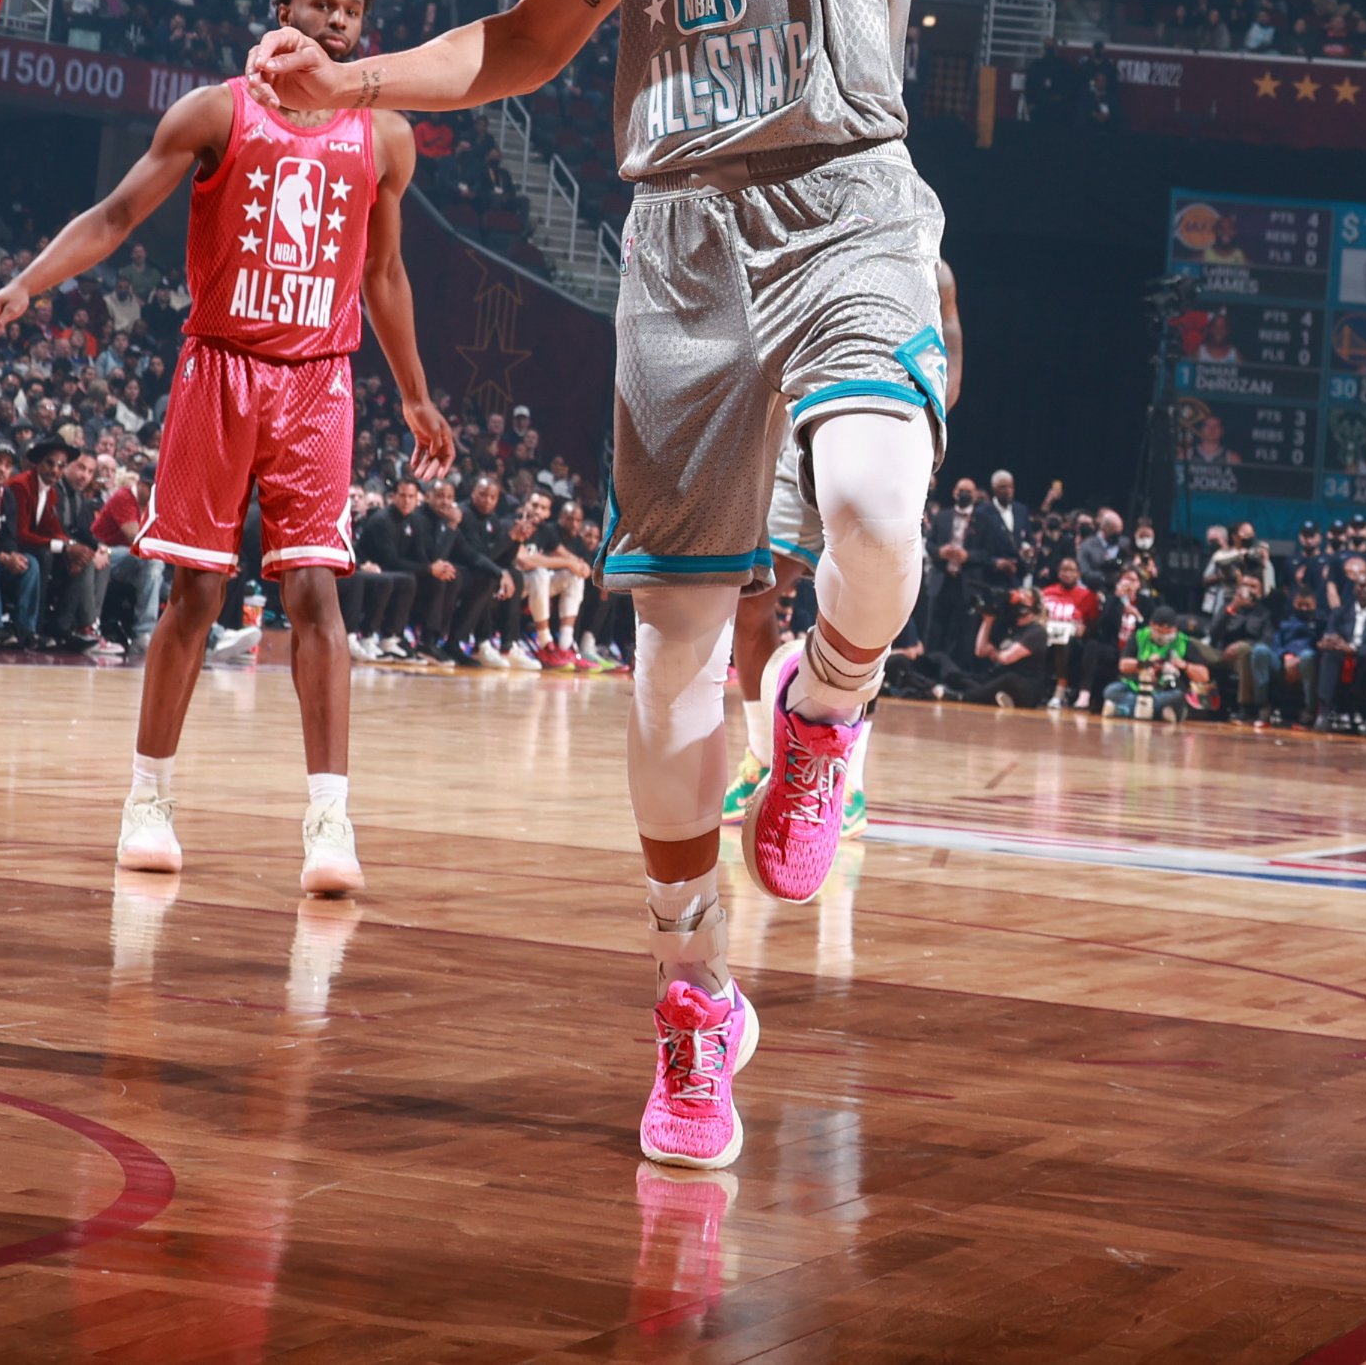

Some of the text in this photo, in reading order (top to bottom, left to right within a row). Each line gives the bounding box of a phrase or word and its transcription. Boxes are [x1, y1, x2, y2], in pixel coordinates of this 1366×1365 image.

[647, 21, 811, 142] ALL-STAR
[1307, 212, 1319, 228] 4
[1306, 232, 1319, 247] 0
[273, 242, 298, 264] NBA
[1305, 251, 1317, 266] 0
[1202, 277, 1259, 295] JAMES
[229, 268, 336, 329] ALL-STAR
[1300, 311, 1312, 327] 4
[1301, 331, 1309, 346] 1
[1298, 350, 1311, 366] 0
[1330, 377, 1358, 399] 30
[1293, 410, 1306, 427] 3
[1292, 430, 1305, 446] 3
[1291, 449, 1304, 465] 0
[1322, 477, 1350, 497] 34
